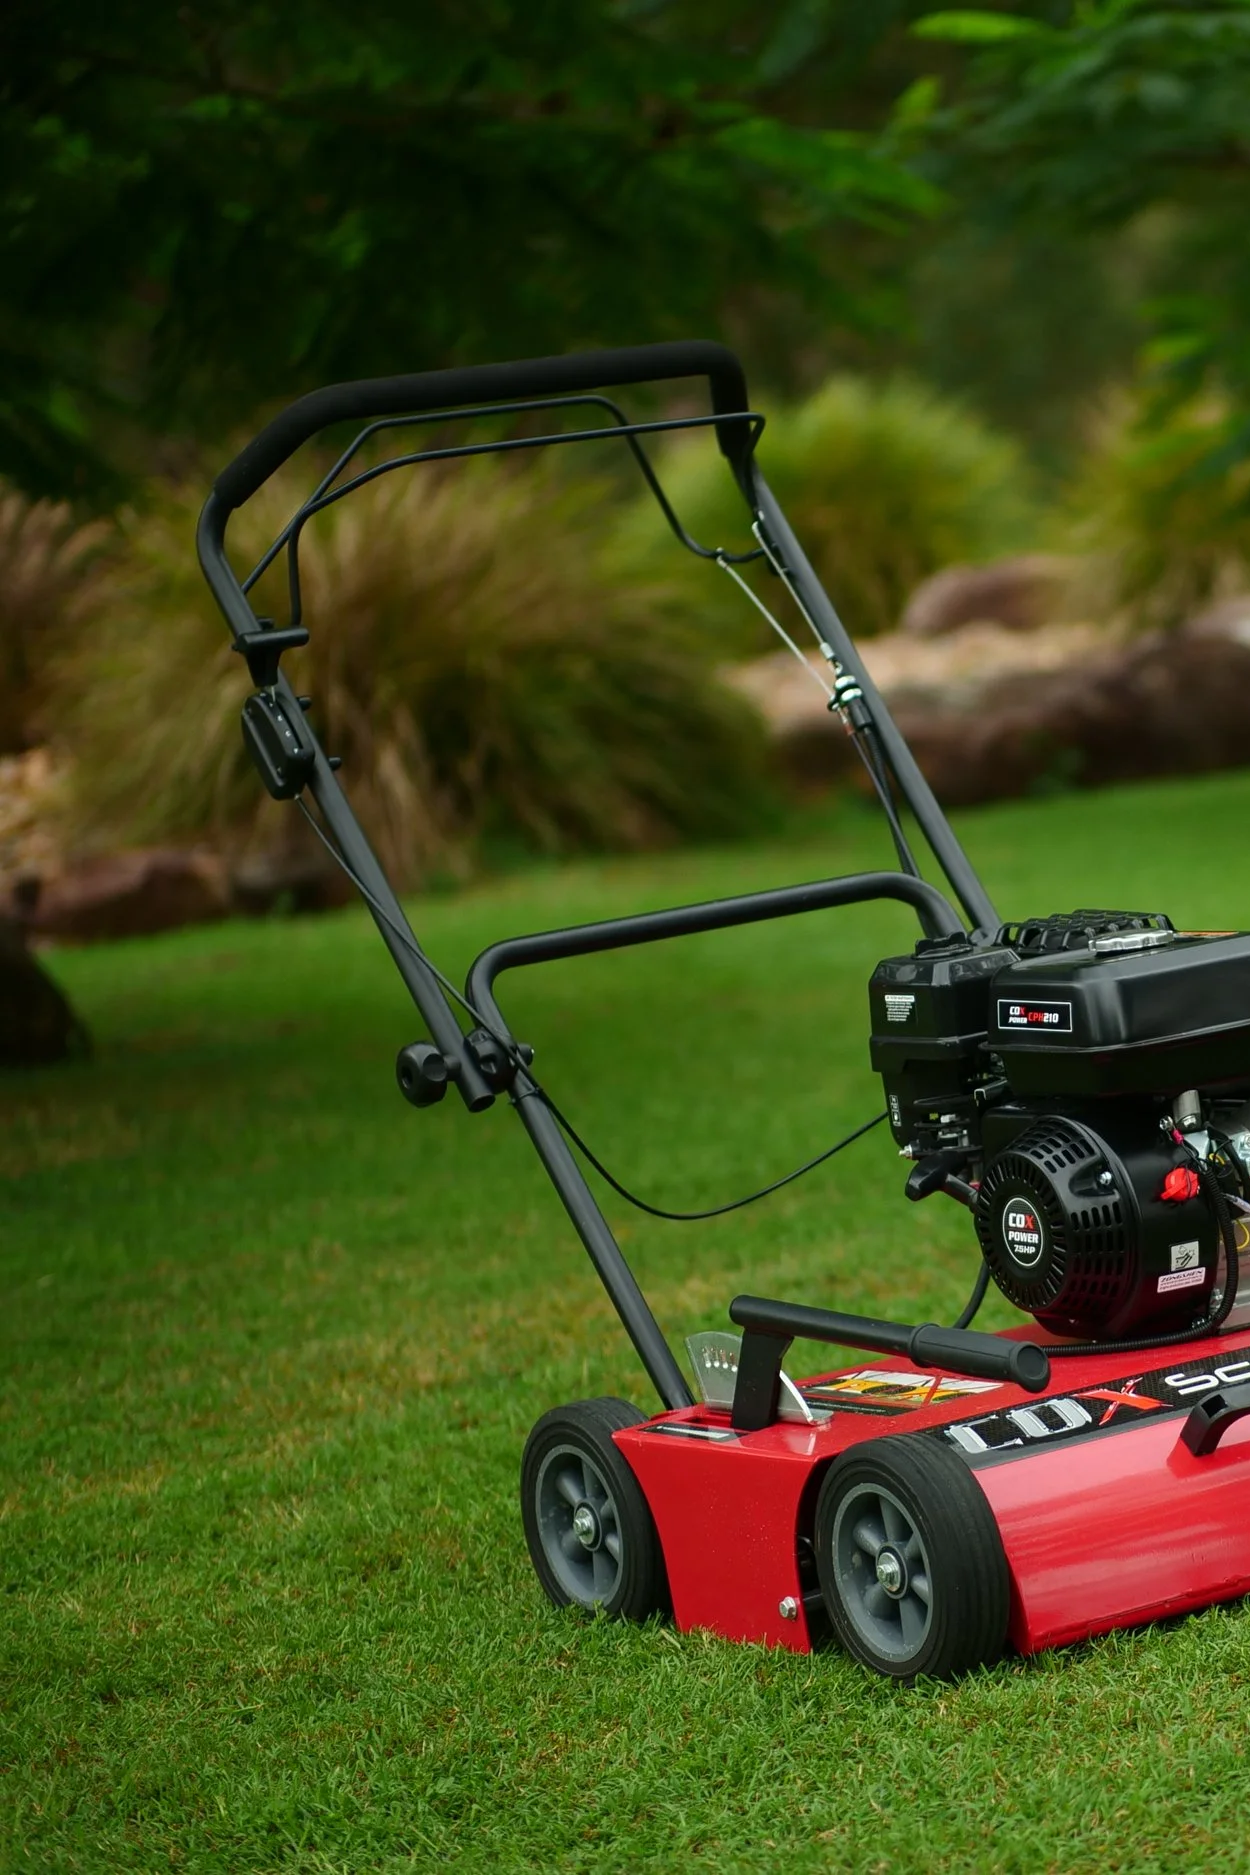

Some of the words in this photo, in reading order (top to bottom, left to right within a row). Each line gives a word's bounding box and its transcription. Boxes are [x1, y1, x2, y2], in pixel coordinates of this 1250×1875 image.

[1009, 1006, 1025, 1015] COX
[1008, 1016, 1028, 1024] POWER
[1028, 1012, 1059, 1023] CPH210
[1008, 1213, 1035, 1229] COX
[1008, 1231, 1039, 1243] POWER
[944, 1376, 1174, 1454] COX
